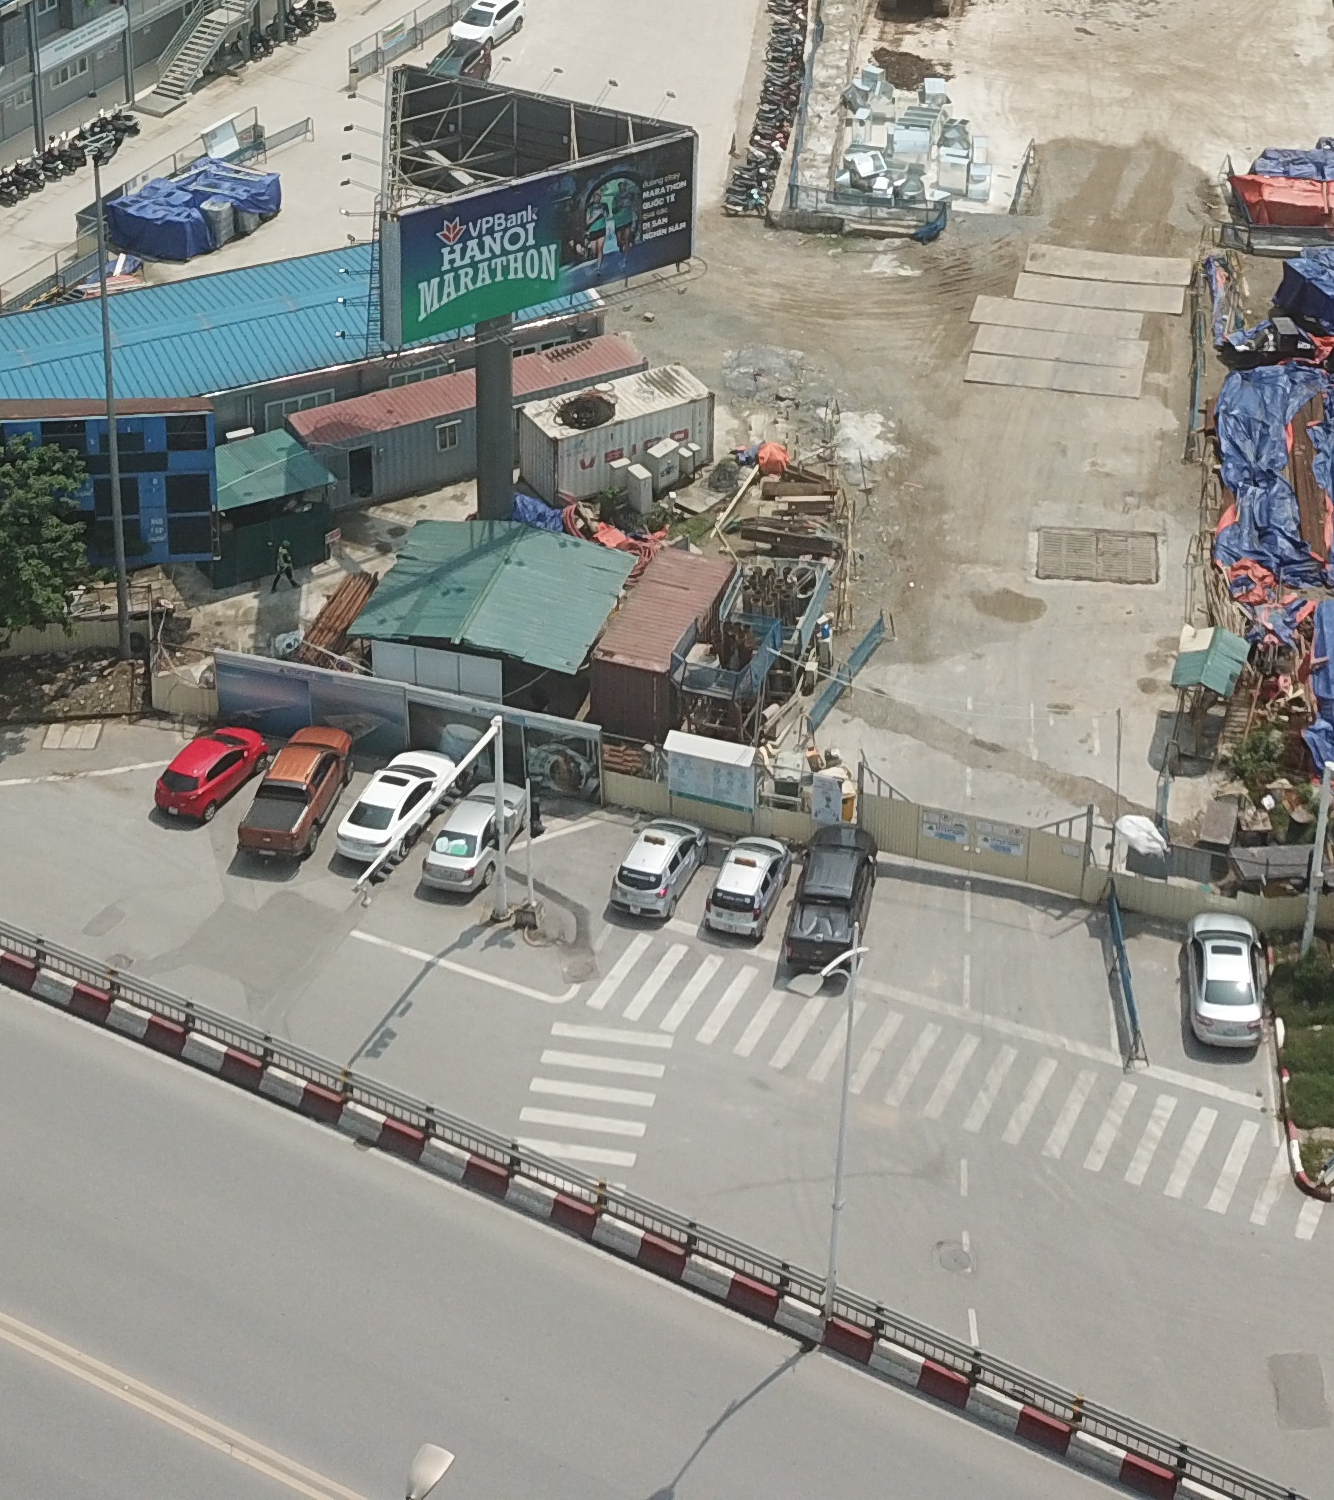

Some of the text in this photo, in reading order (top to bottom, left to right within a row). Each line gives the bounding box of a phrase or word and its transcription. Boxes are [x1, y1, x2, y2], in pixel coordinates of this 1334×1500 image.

[642, 179, 688, 200] MARATHON
[469, 204, 539, 237] VPBank
[441, 222, 536, 272] HANOI
[417, 243, 558, 322] MARATHON
